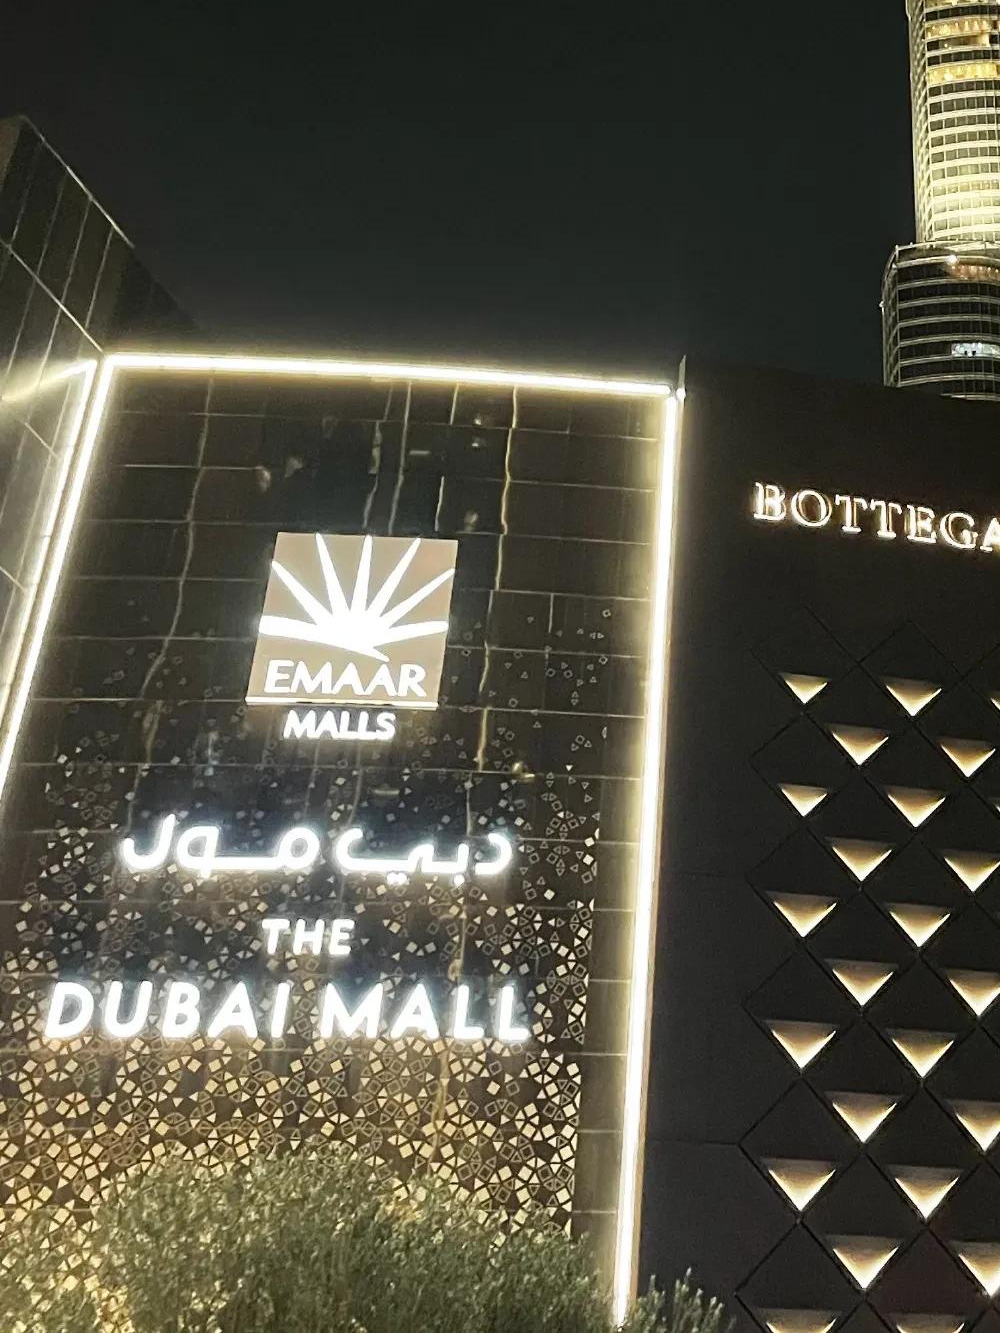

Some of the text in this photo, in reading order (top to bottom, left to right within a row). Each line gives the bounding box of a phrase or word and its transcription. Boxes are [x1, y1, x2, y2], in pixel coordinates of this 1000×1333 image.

[264, 659, 427, 697] EMAAR
[283, 709, 396, 740] MALLS
[123, 814, 513, 886] دبي مول
[262, 918, 355, 956] THE
[44, 980, 530, 1042] DUBAI MALL
